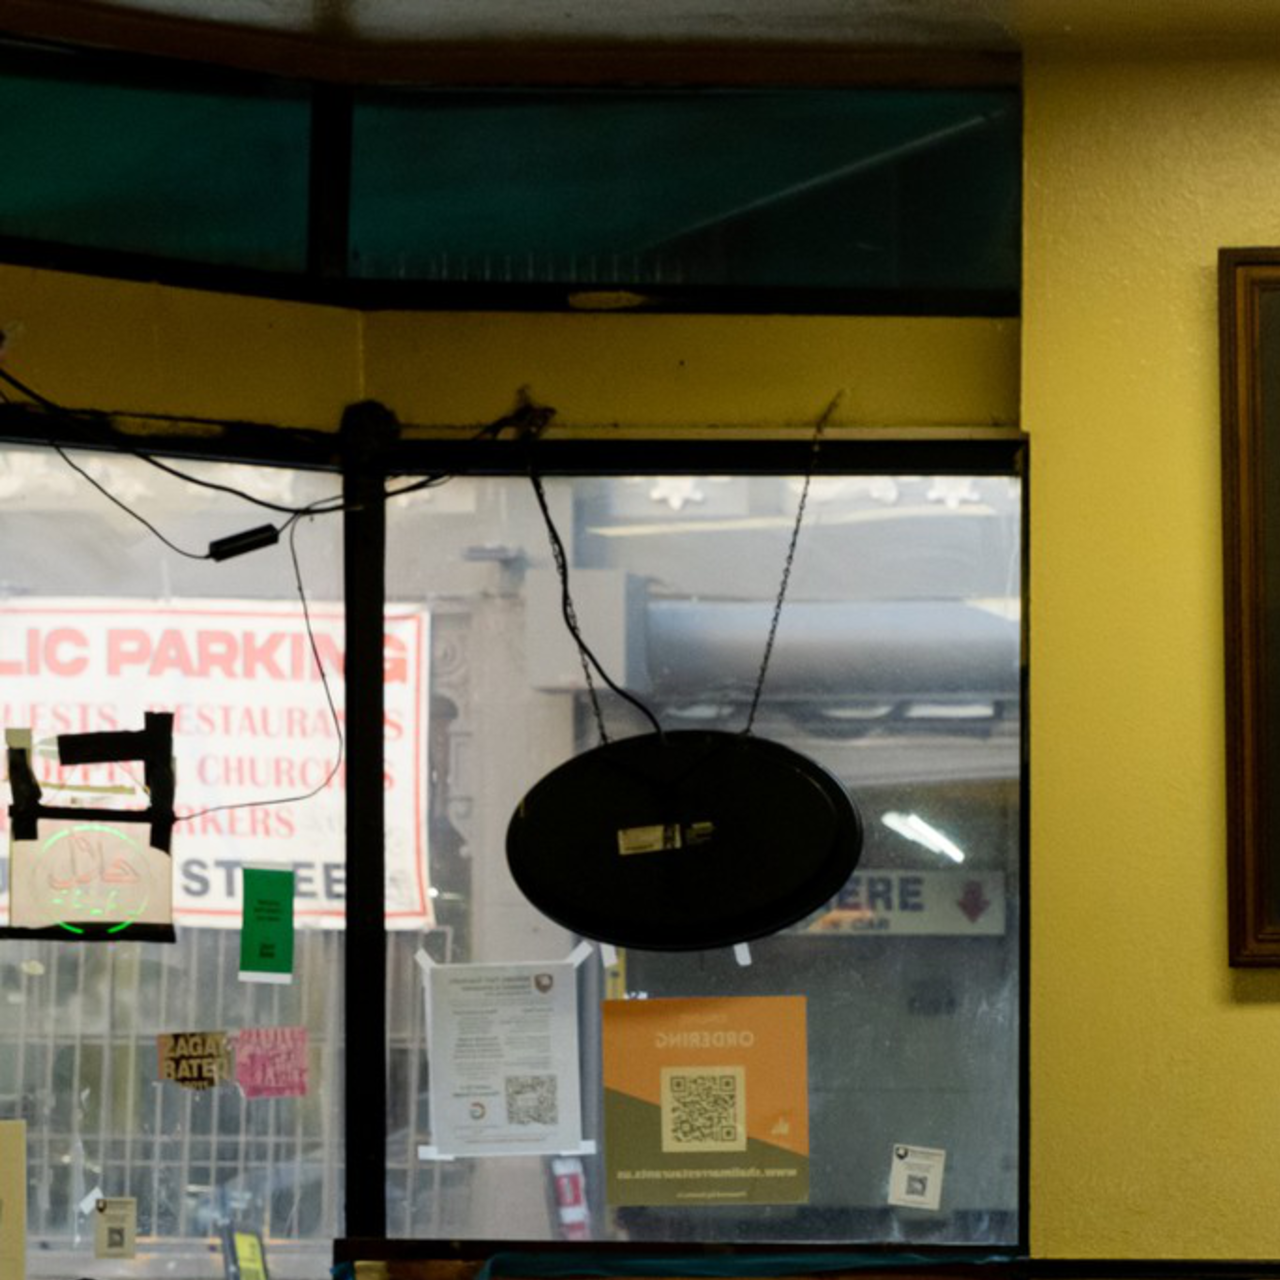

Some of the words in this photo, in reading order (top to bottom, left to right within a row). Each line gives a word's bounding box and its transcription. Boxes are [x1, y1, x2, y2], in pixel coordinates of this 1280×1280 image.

[147, 703, 404, 741] ESTAURAS
[199, 753, 394, 791] CHURCHS
[181, 858, 345, 900] STEE
[828, 876, 924, 912] ERE
